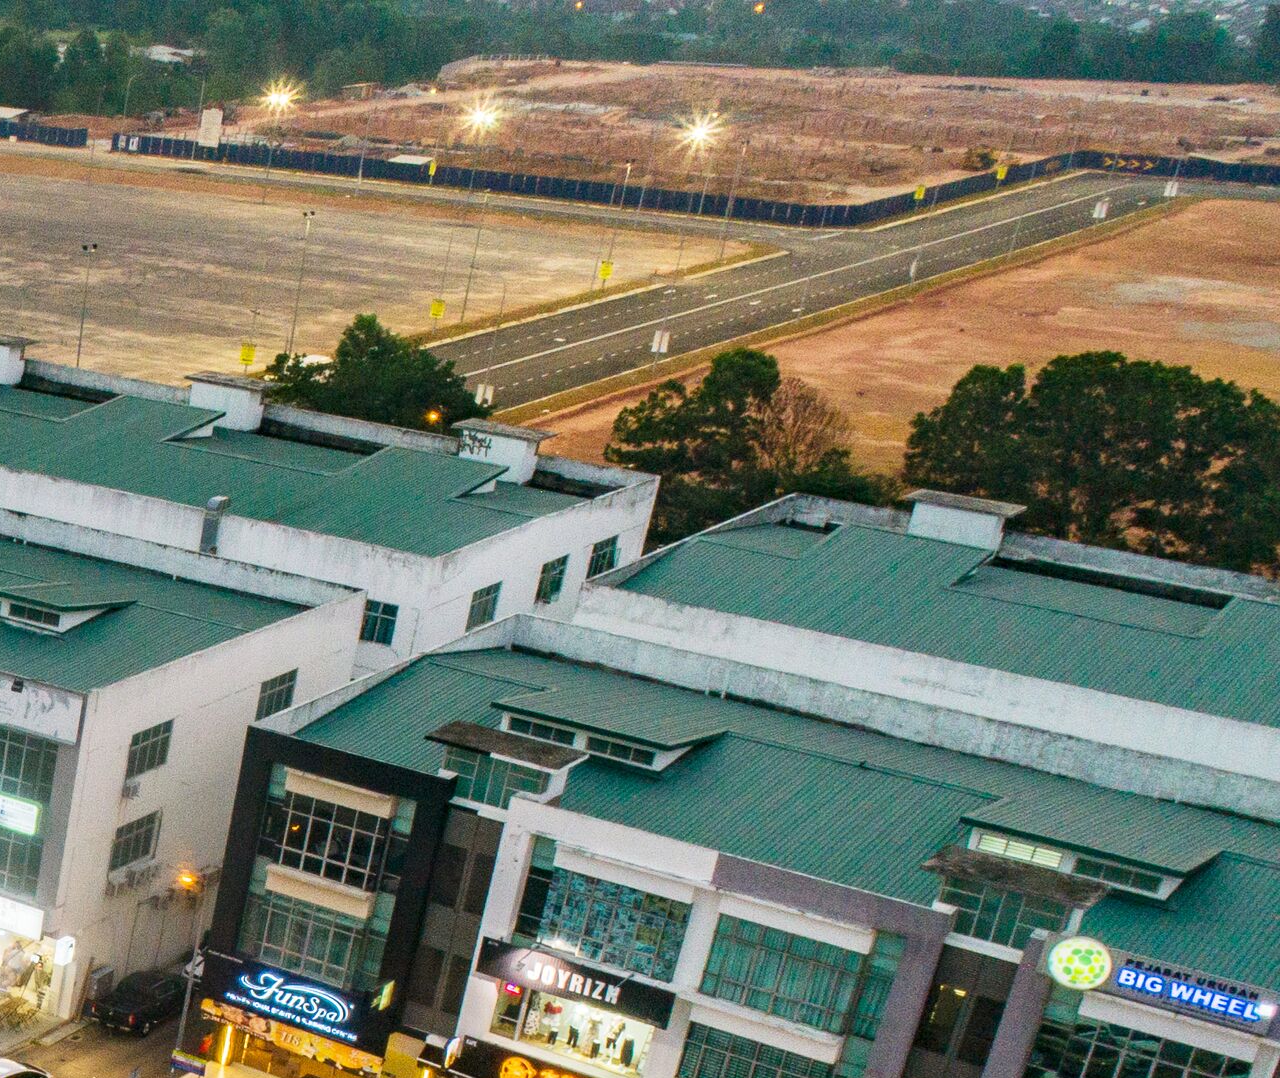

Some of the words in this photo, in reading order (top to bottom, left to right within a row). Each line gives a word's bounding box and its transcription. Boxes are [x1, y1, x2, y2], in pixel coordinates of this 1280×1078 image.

[1117, 967, 1164, 994] BIG
[1169, 981, 1260, 1021] WHEEL
[1125, 957, 1192, 982] PEJABAT
[1196, 976, 1260, 1000] URUSAN
